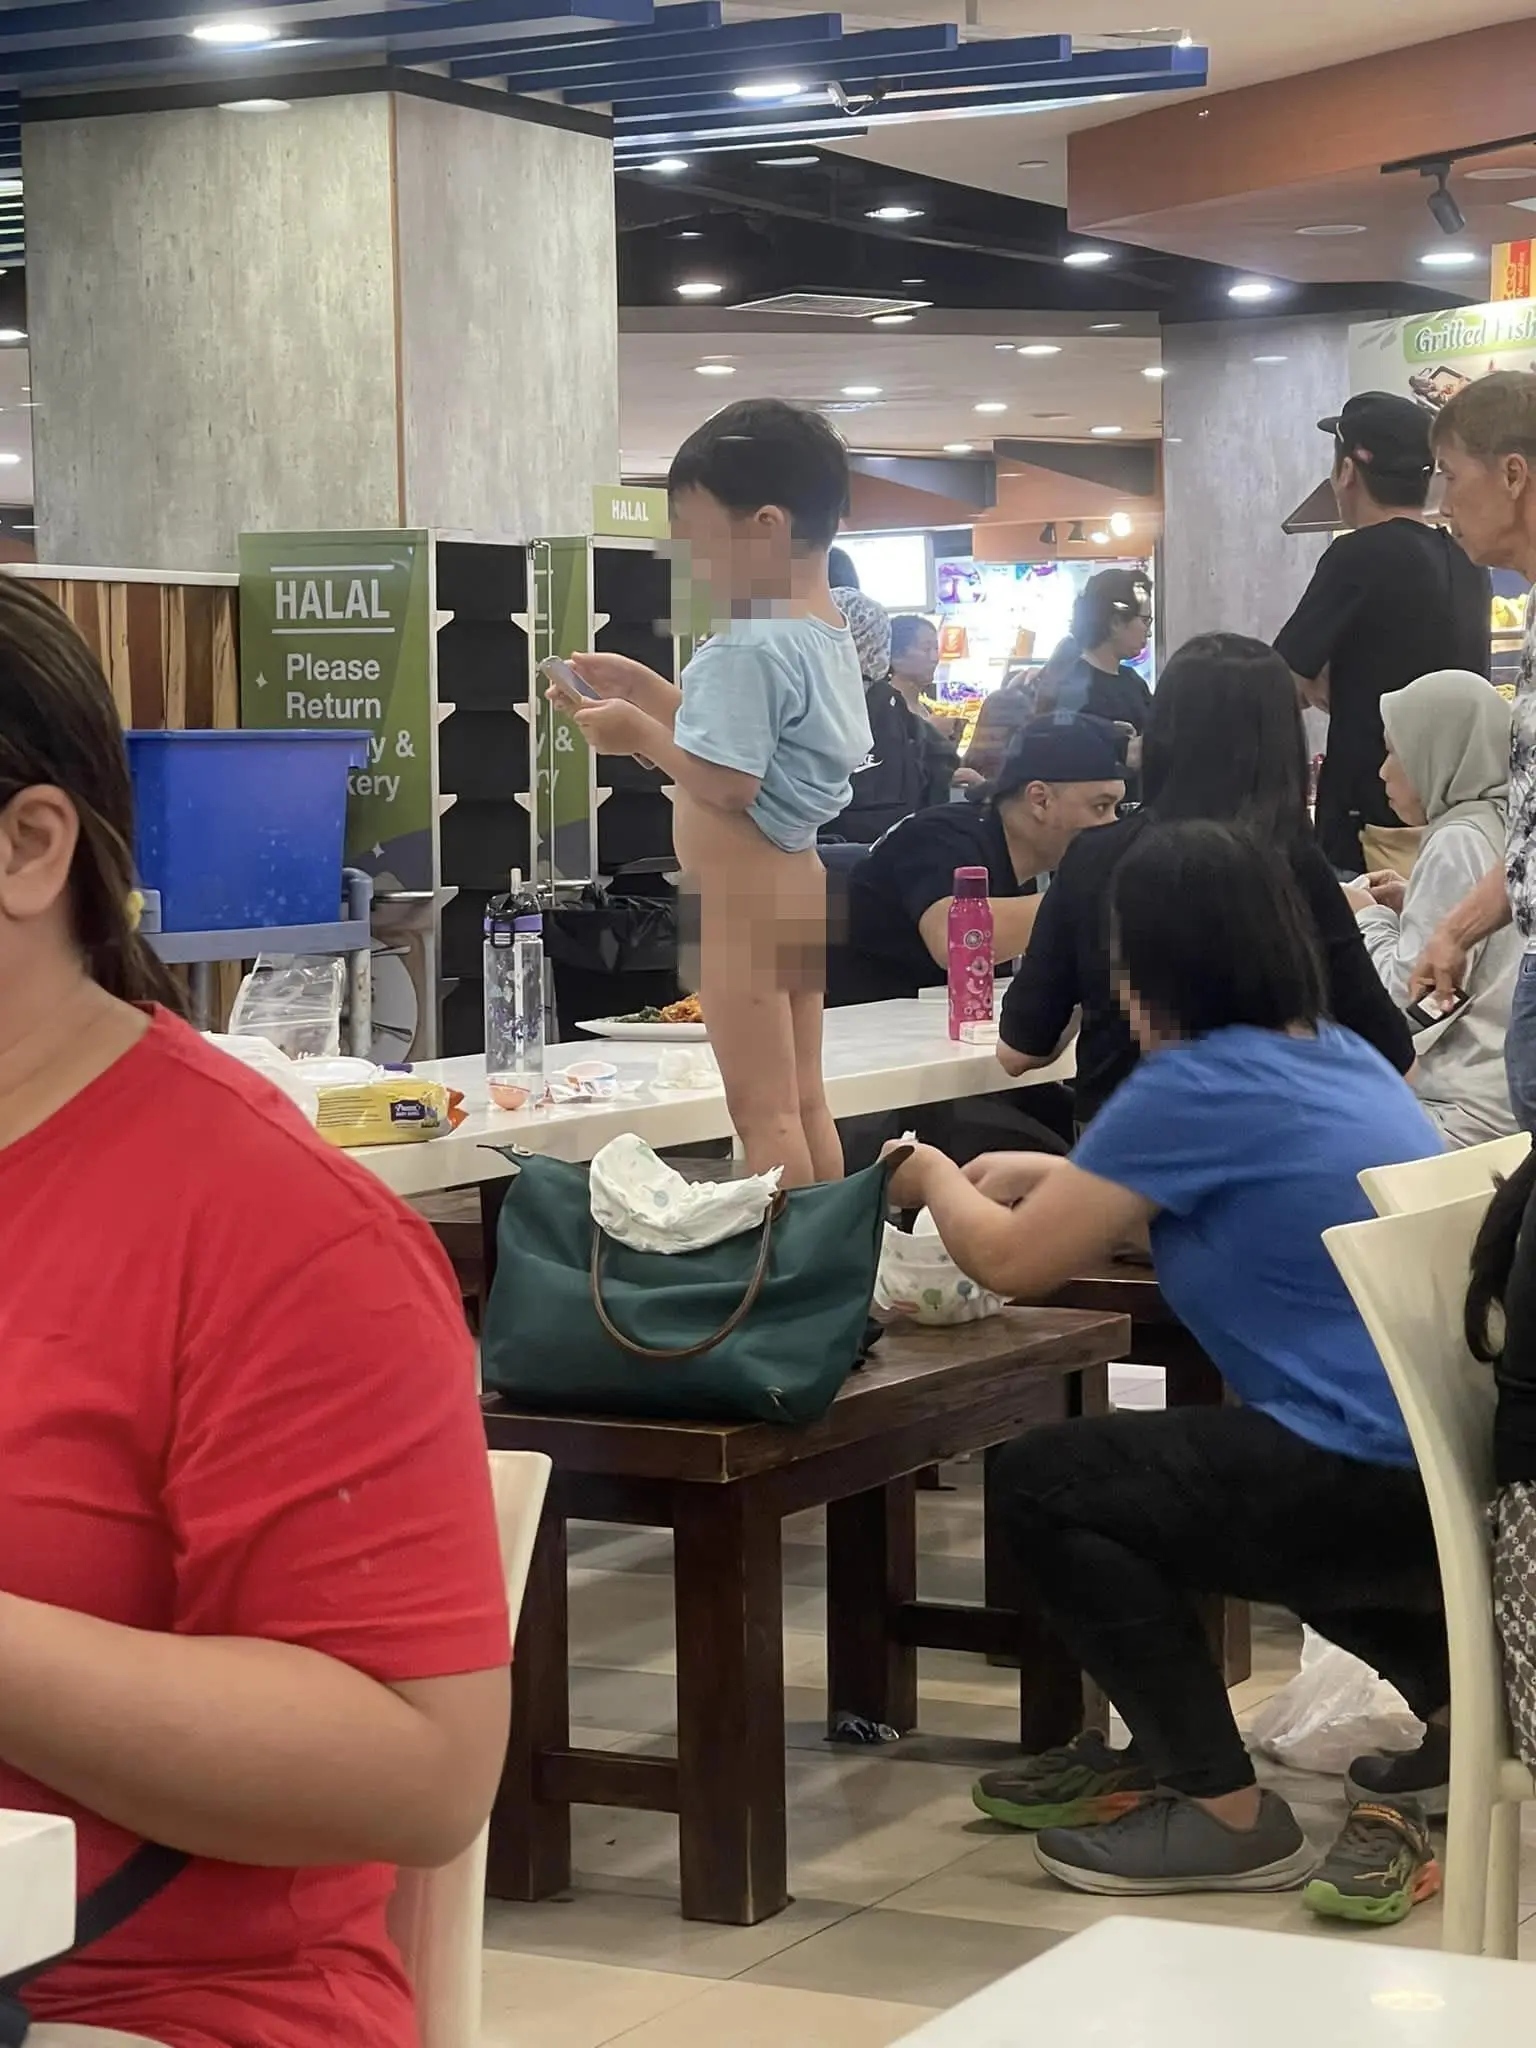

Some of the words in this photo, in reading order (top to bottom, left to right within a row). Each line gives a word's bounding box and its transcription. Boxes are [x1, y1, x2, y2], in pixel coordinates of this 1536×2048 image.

[1416, 318, 1487, 353] Grilled
[611, 499, 649, 521] HALAL
[275, 579, 391, 619] HALAL
[287, 653, 381, 681] Please
[287, 691, 382, 719] Return
